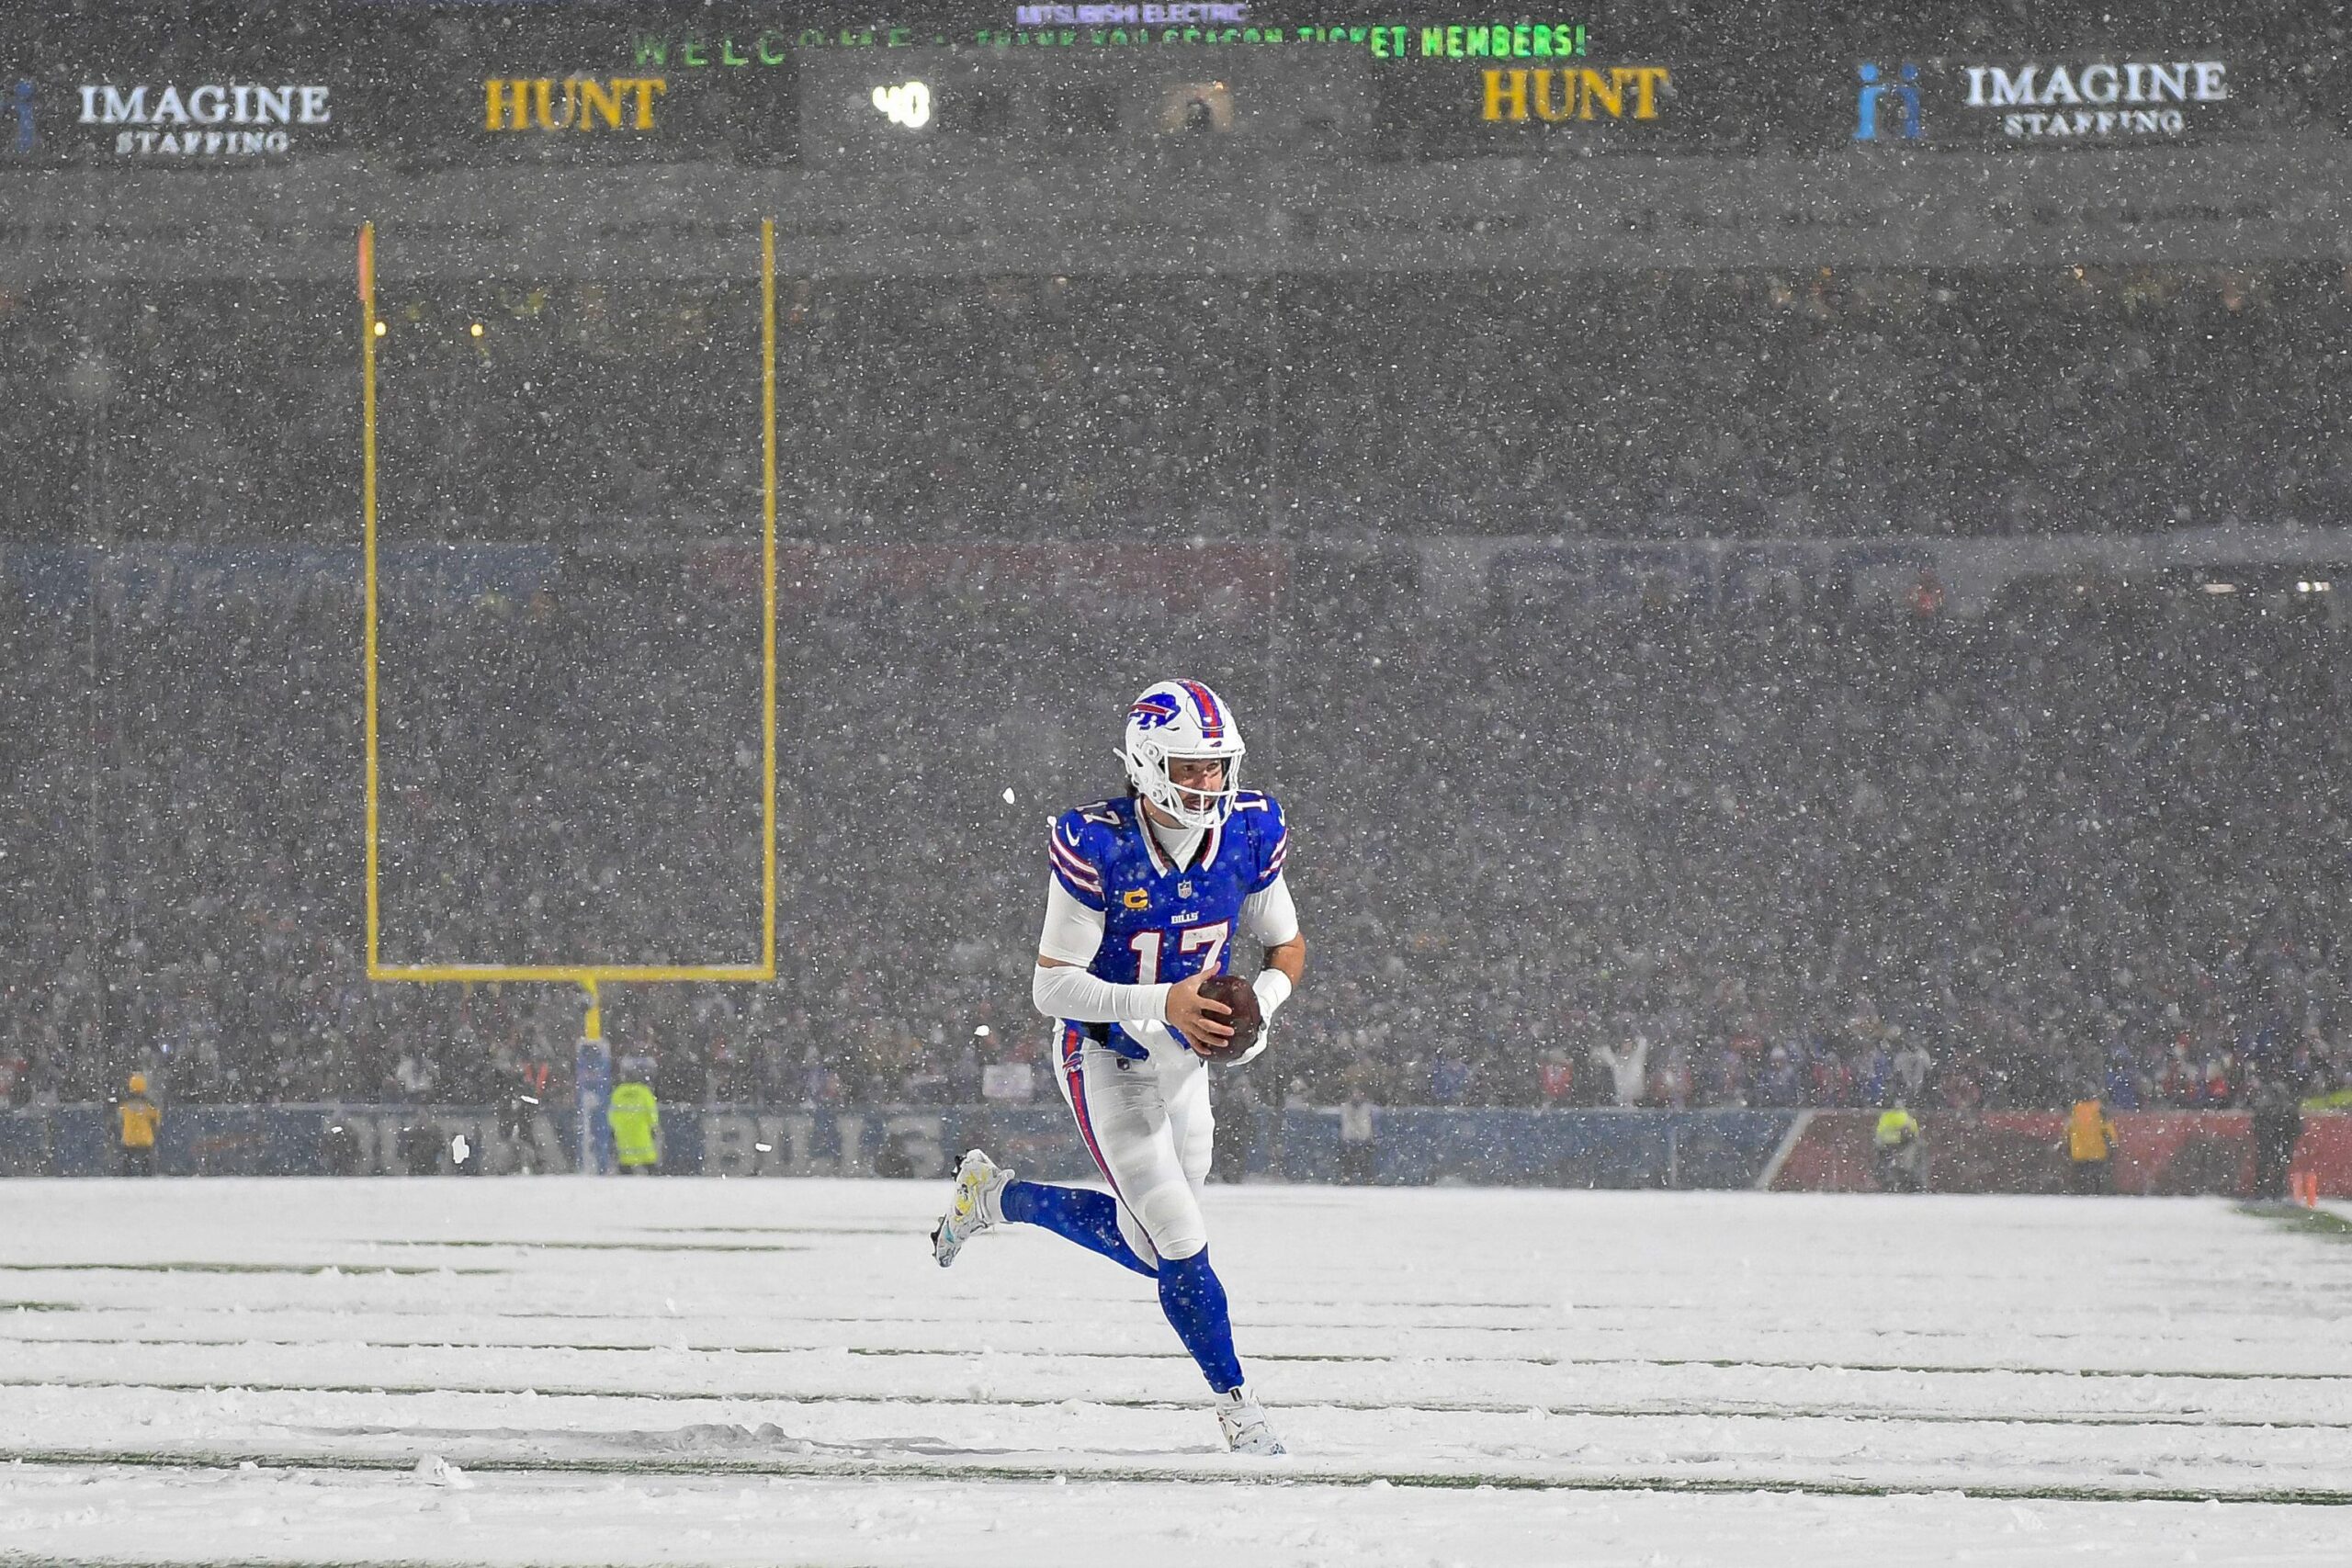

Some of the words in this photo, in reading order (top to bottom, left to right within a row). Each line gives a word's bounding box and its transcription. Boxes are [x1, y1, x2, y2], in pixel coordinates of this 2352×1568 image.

[1420, 24, 1586, 58] MEMBERS!
[1481, 67, 1669, 122] HUNT
[1964, 61, 2230, 107] IMAGINE
[77, 85, 332, 126] IMAGINE
[483, 78, 668, 131] HUNT
[2003, 108, 2185, 137] STAFFING
[115, 130, 289, 154] STAFFING
[1124, 887, 1148, 909] C
[1170, 911, 1199, 925] BILLS
[1129, 919, 1229, 985] 17
